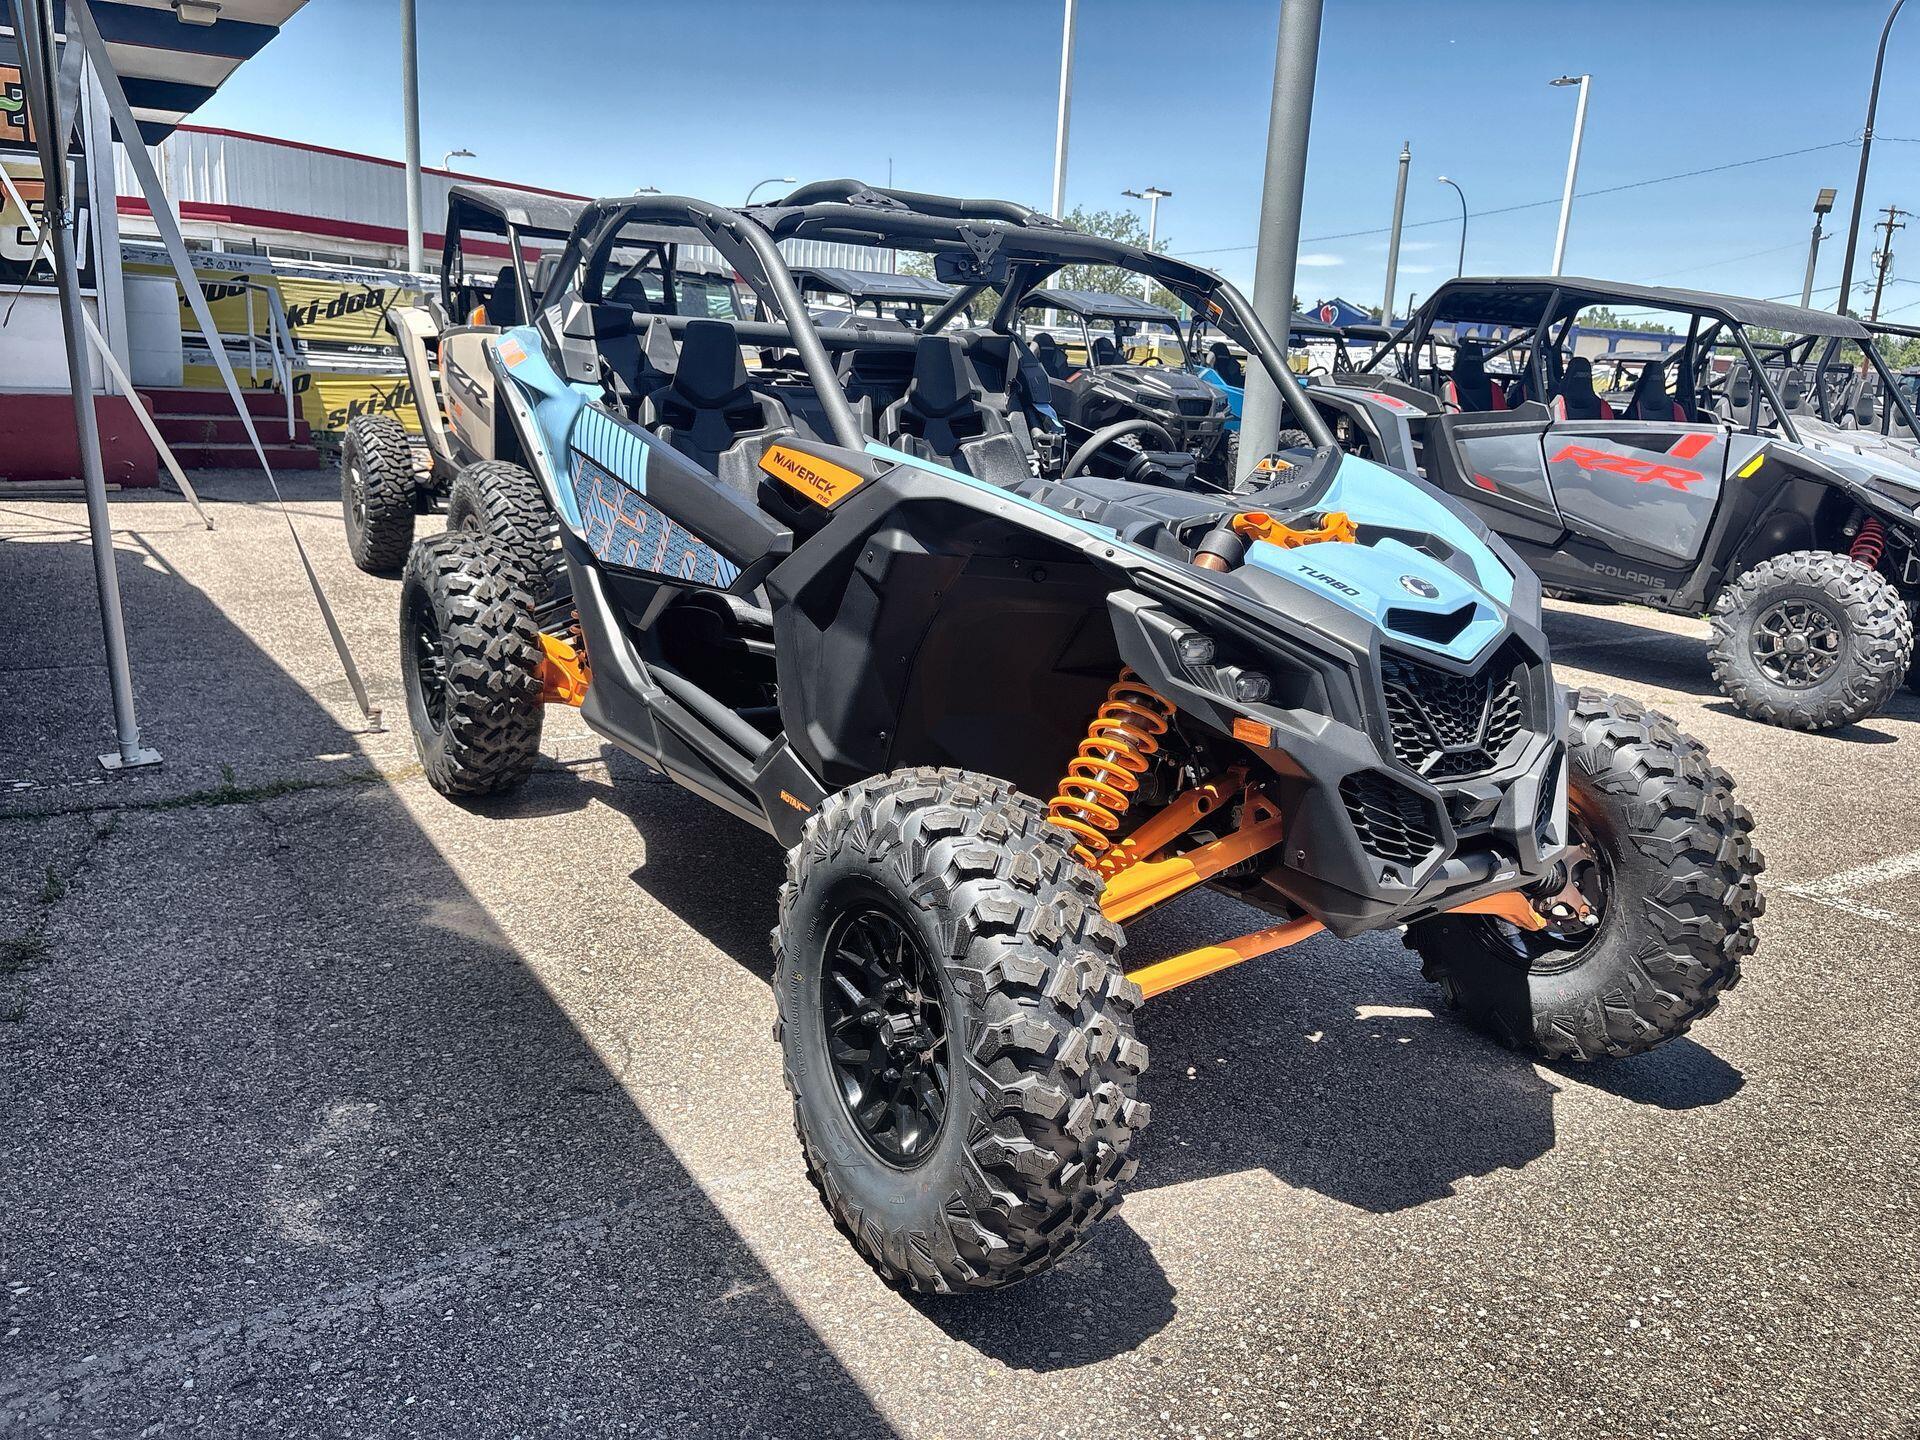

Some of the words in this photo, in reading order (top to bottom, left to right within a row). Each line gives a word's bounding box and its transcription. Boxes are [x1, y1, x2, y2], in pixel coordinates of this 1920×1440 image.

[773, 451, 837, 497] MAVERICK
[1549, 445, 1706, 493] RZR
[1298, 564, 1361, 598] TURBO
[1593, 562, 1666, 588] POLARIS
